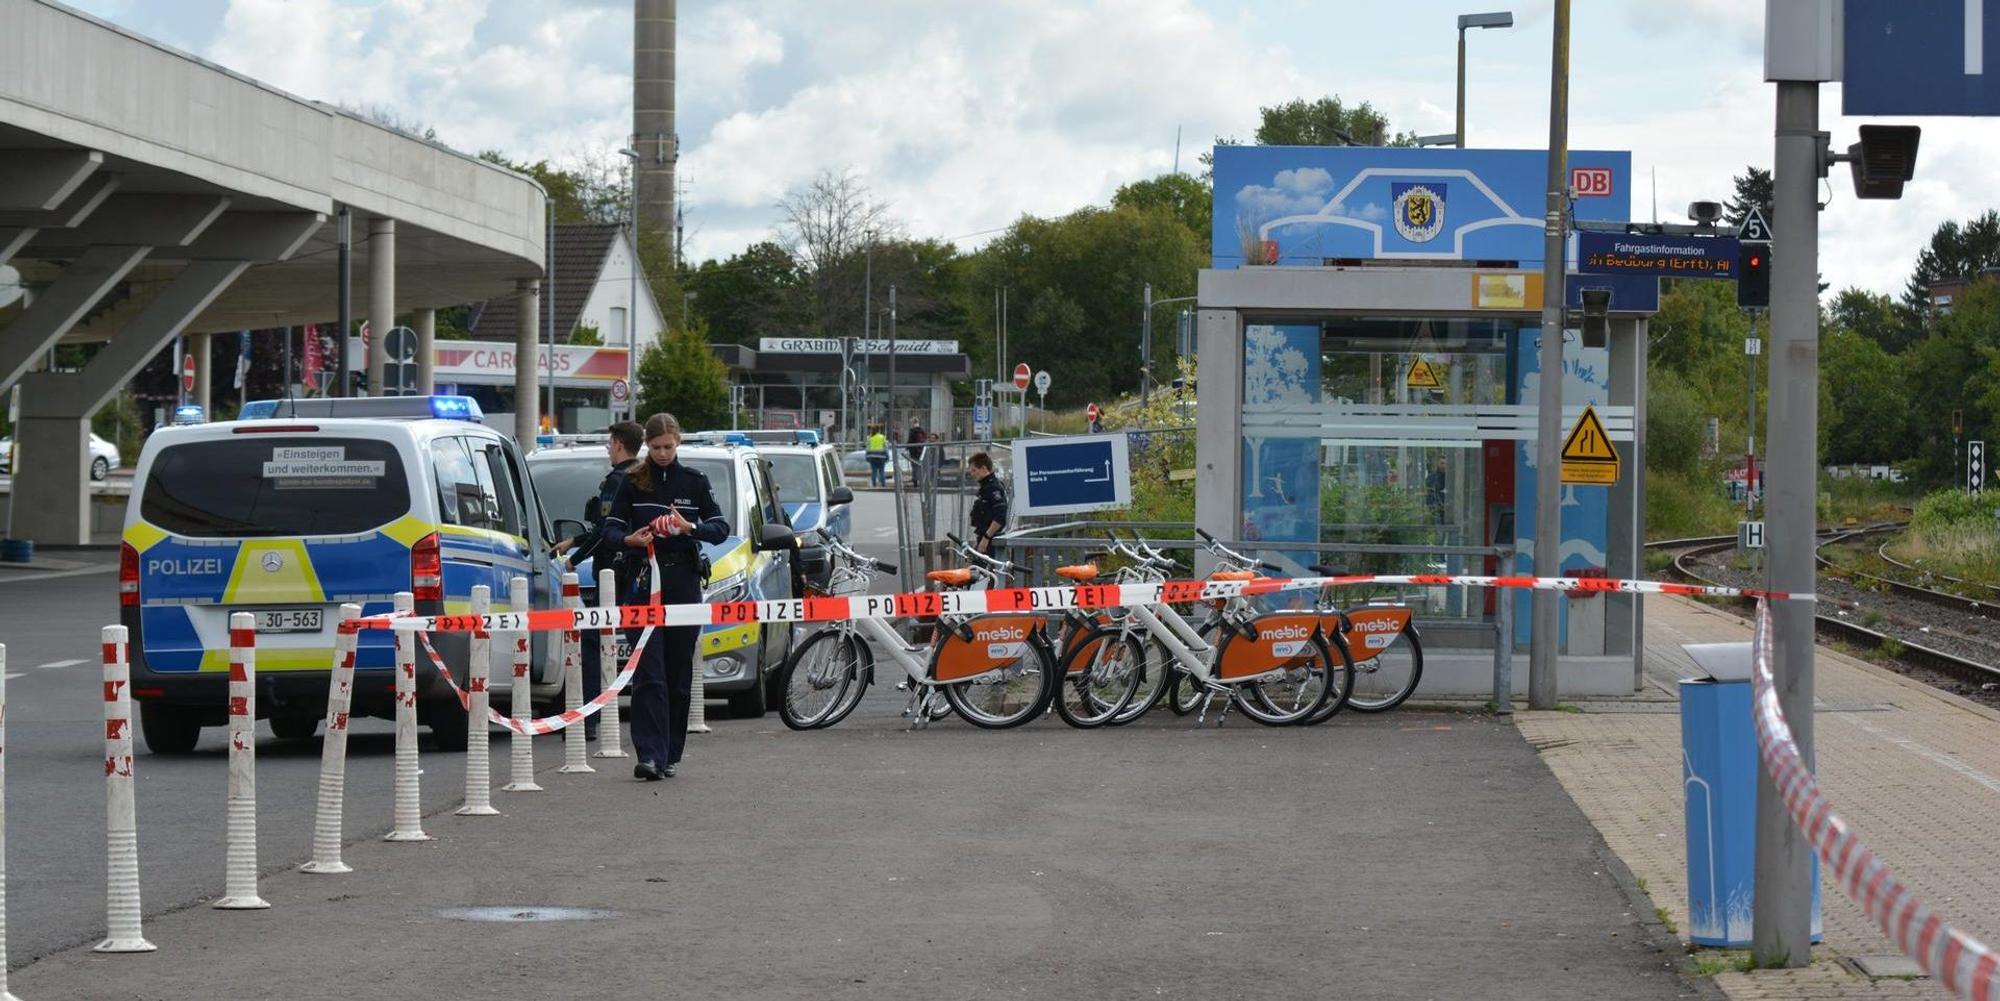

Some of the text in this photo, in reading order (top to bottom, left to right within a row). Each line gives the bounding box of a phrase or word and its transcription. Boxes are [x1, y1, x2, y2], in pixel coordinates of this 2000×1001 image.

[1576, 172, 1607, 192] DB
[1749, 219, 1760, 239] 5
[1614, 242, 1705, 256] Fahrgastinformation
[781, 339, 863, 351] GRABME
[474, 350, 571, 371] CARASS
[615, 384, 625, 394] 30
[267, 463, 288, 474] und
[1751, 524, 1762, 544] H
[148, 559, 222, 575] POLIZEI
[426, 614, 520, 630] POLIZEI
[574, 605, 666, 626] POLIZEI
[720, 602, 814, 621] POLIZEI
[868, 595, 961, 615] POLIZEI
[1014, 587, 1105, 608] POLIZEI
[266, 612, 318, 627] 30-563
